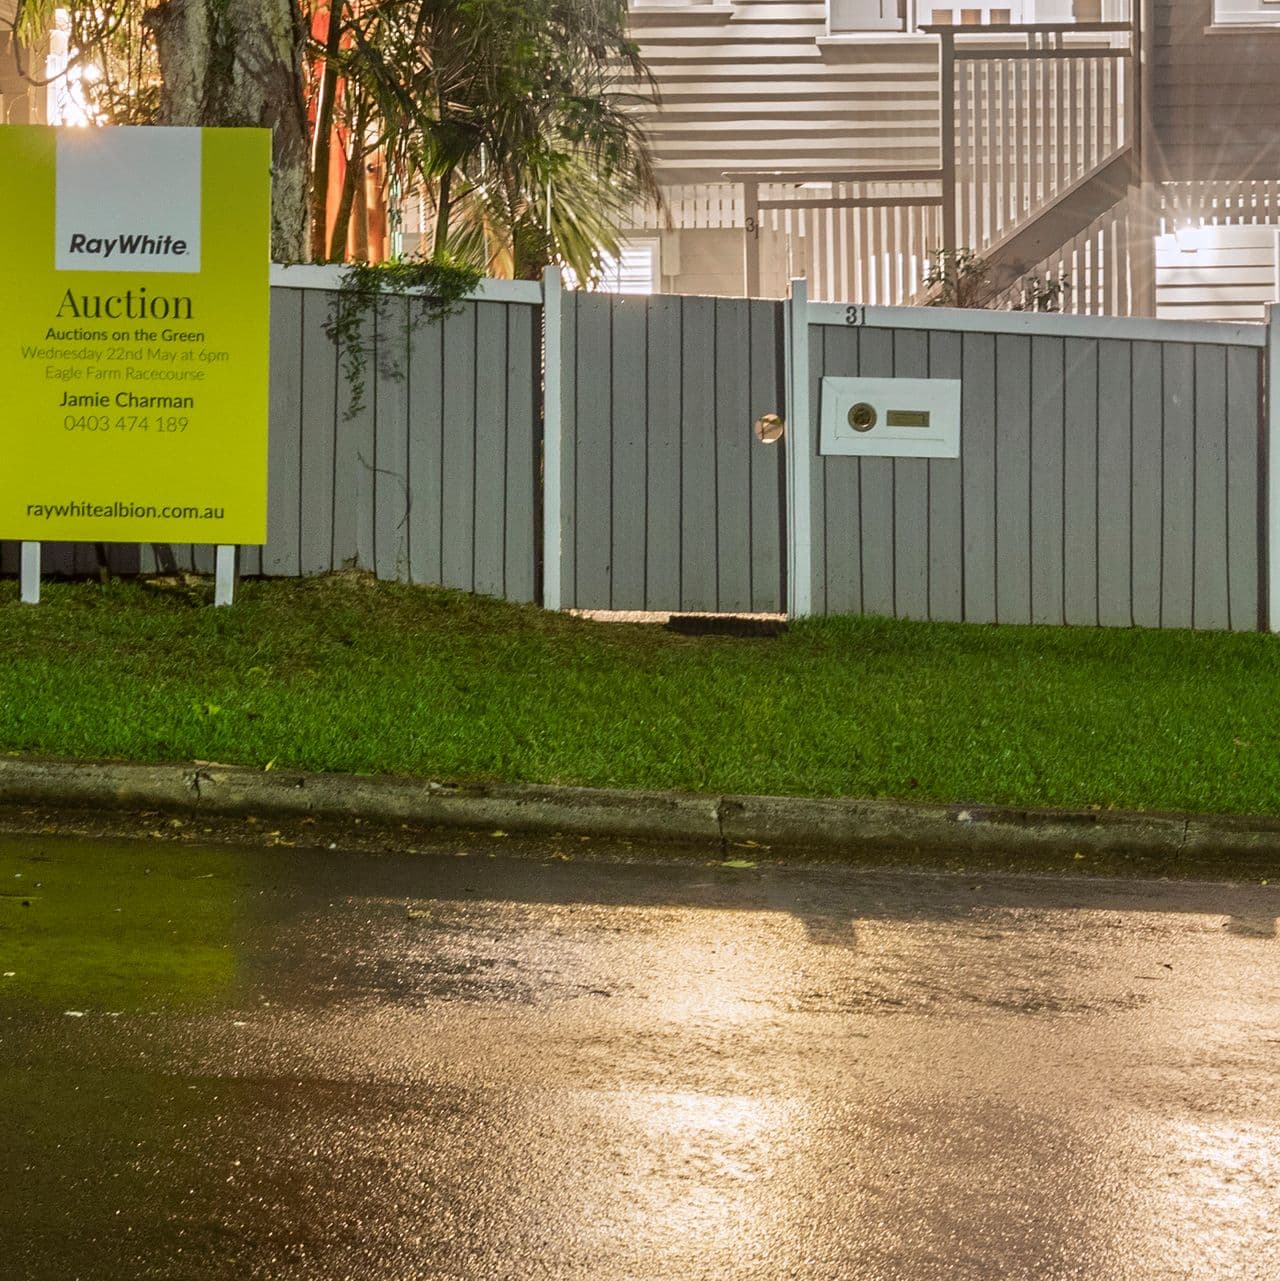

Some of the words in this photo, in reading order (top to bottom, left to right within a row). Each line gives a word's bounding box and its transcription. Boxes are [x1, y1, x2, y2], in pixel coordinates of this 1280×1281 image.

[745, 217, 759, 240] 31
[55, 287, 194, 319] Auction
[846, 305, 866, 325] 31
[45, 328, 108, 341] Auctions
[112, 331, 130, 341] on
[135, 329, 157, 341] the
[161, 329, 205, 342] Green
[21, 346, 102, 360] Wednesday
[107, 347, 143, 360] 22nd
[147, 348, 176, 361] May
[180, 350, 193, 361] at
[198, 350, 230, 363] 6pm
[45, 366, 81, 381] Eagle
[86, 367, 120, 379] Farm
[125, 367, 205, 381] Racecourse
[59, 392, 110, 407] Jamie
[115, 392, 194, 408] Charman
[63, 416, 110, 431] 0403
[115, 416, 150, 431] 474
[156, 416, 189, 432] 189
[26, 501, 225, 519] raywhitealbion.com.au
